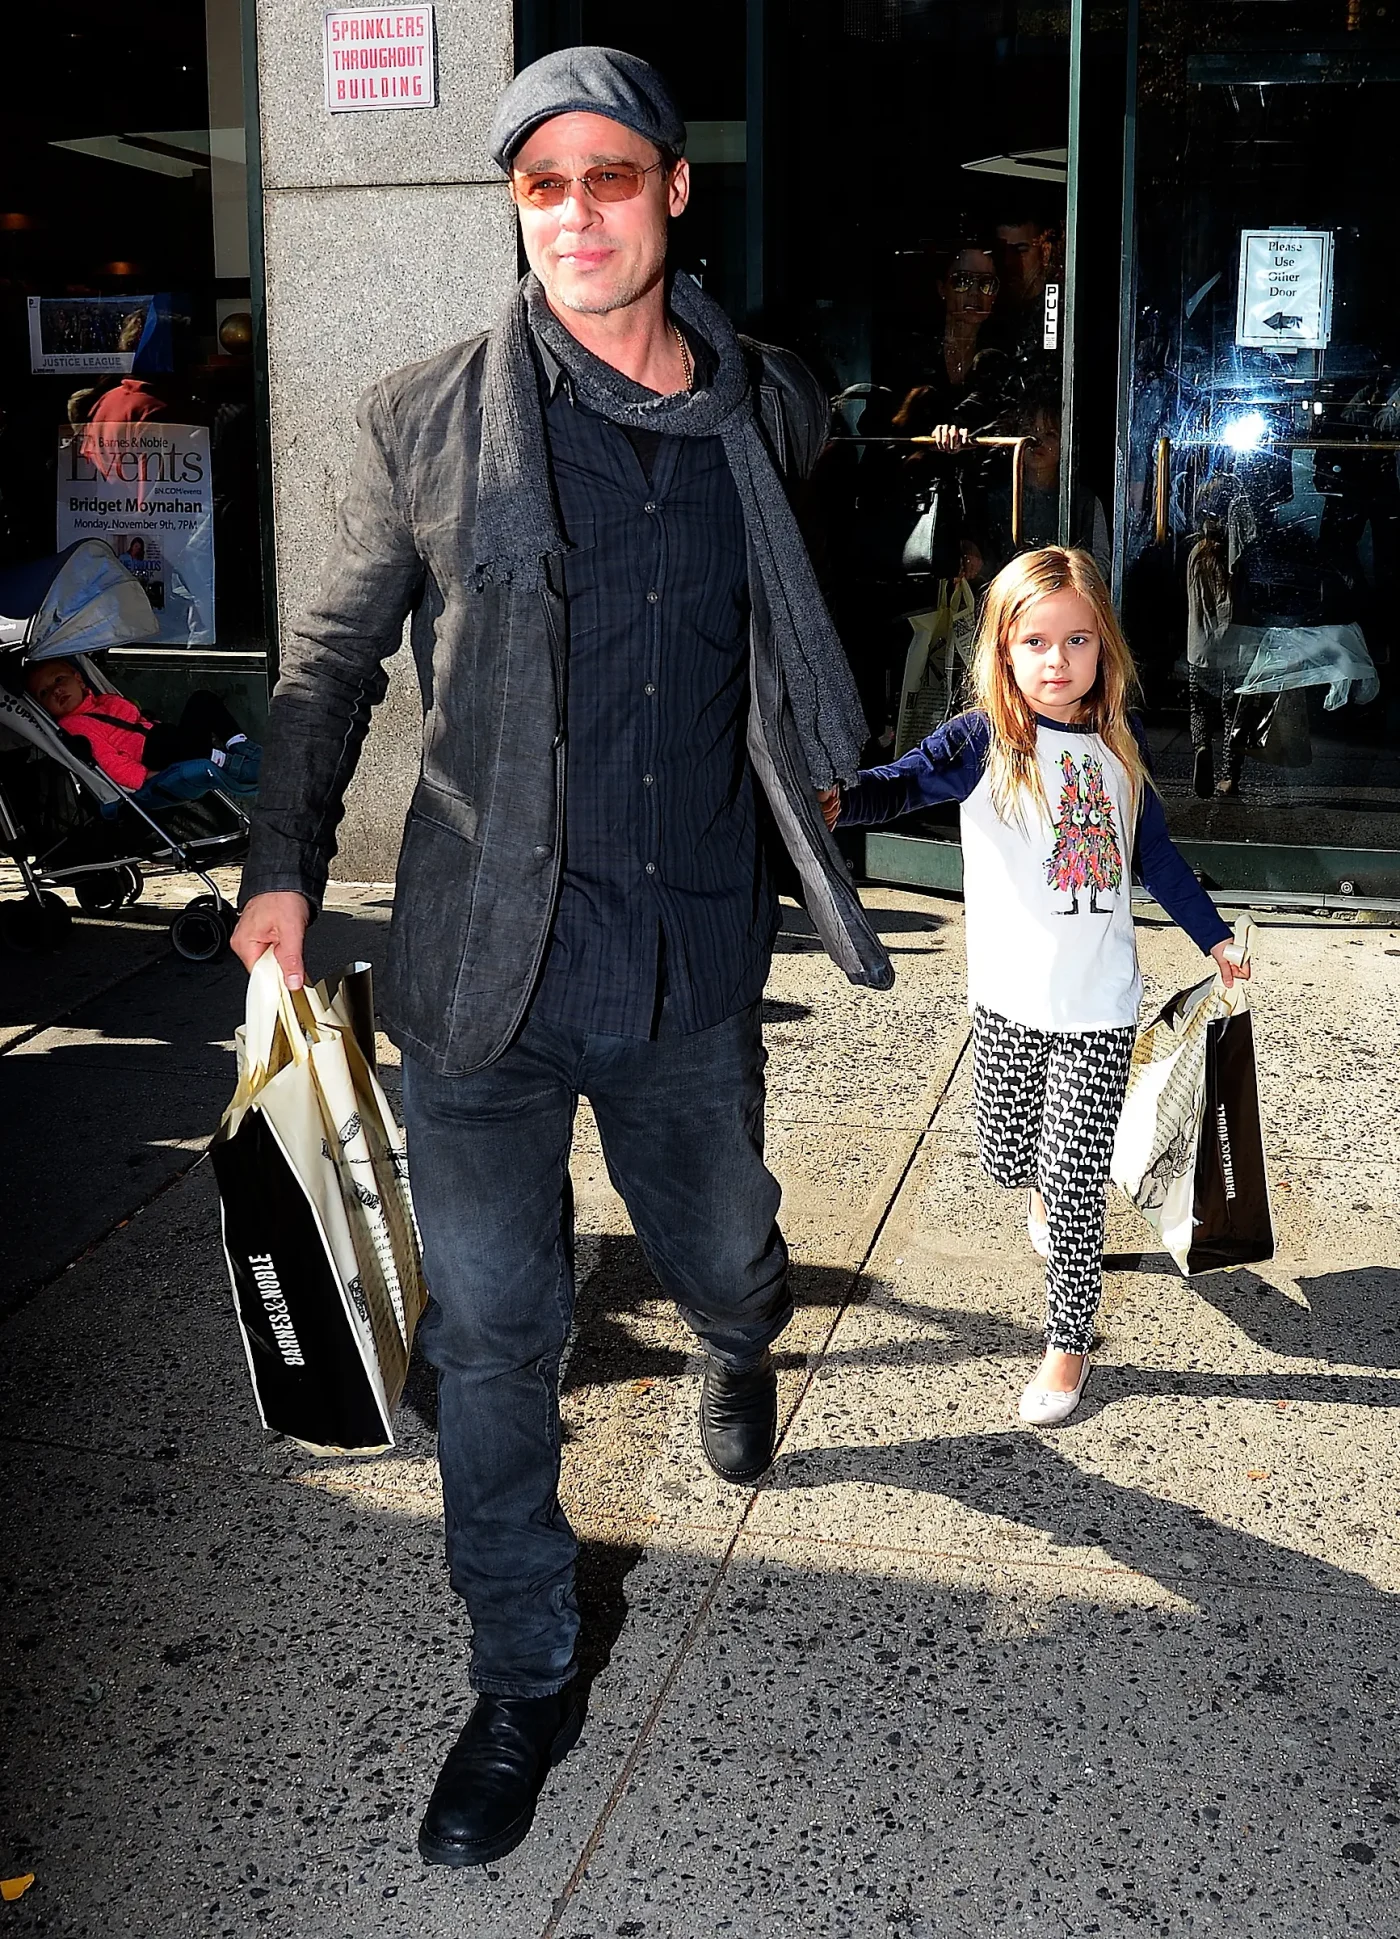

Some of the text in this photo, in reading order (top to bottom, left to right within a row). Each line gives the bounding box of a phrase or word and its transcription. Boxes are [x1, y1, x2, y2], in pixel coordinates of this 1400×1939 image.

[332, 16, 424, 42] SPRINKLERS
[332, 46, 425, 70] THROUGHOUT
[337, 75, 422, 100] BUILDING
[1268, 241, 1302, 252] Please
[1274, 256, 1295, 267] Use
[1268, 271, 1300, 282] Other
[1269, 286, 1297, 297] Door
[1045, 286, 1057, 334] PULL
[42, 357, 122, 367] JUSTICE LEAGUE
[99, 437, 169, 448] Barnes & Noble
[66, 434, 204, 483] Events
[69, 497, 203, 516] Bridget Moynahan
[112, 519, 158, 529] November
[159, 519, 176, 531] 9th,
[178, 520, 198, 530] 7PM
[248, 1253, 305, 1366] BARNES&NOBLE
